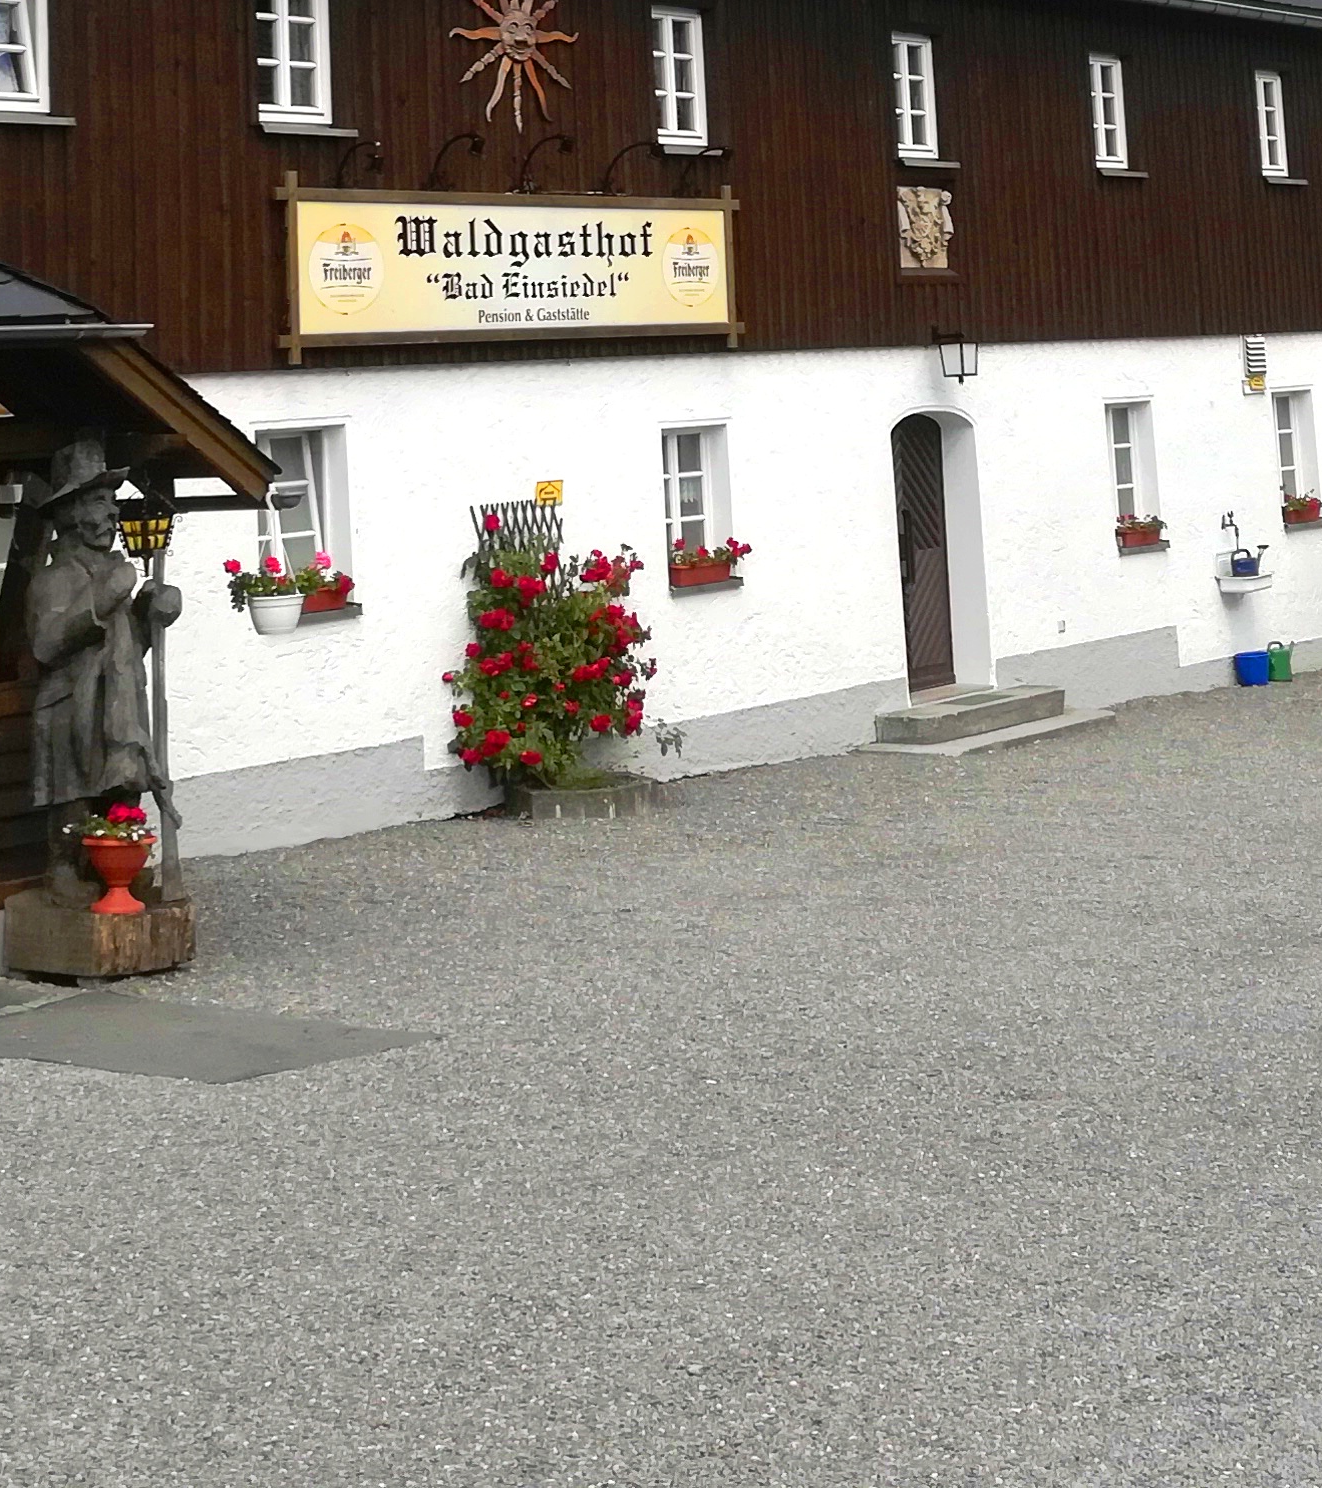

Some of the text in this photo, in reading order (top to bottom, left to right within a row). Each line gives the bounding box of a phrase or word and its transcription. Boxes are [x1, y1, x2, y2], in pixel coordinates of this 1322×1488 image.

[394, 215, 654, 268] Waldgasthof
[322, 262, 372, 285] Freiberger
[672, 261, 710, 281] Freiberger
[478, 307, 590, 324] Pension & Gaststätte
